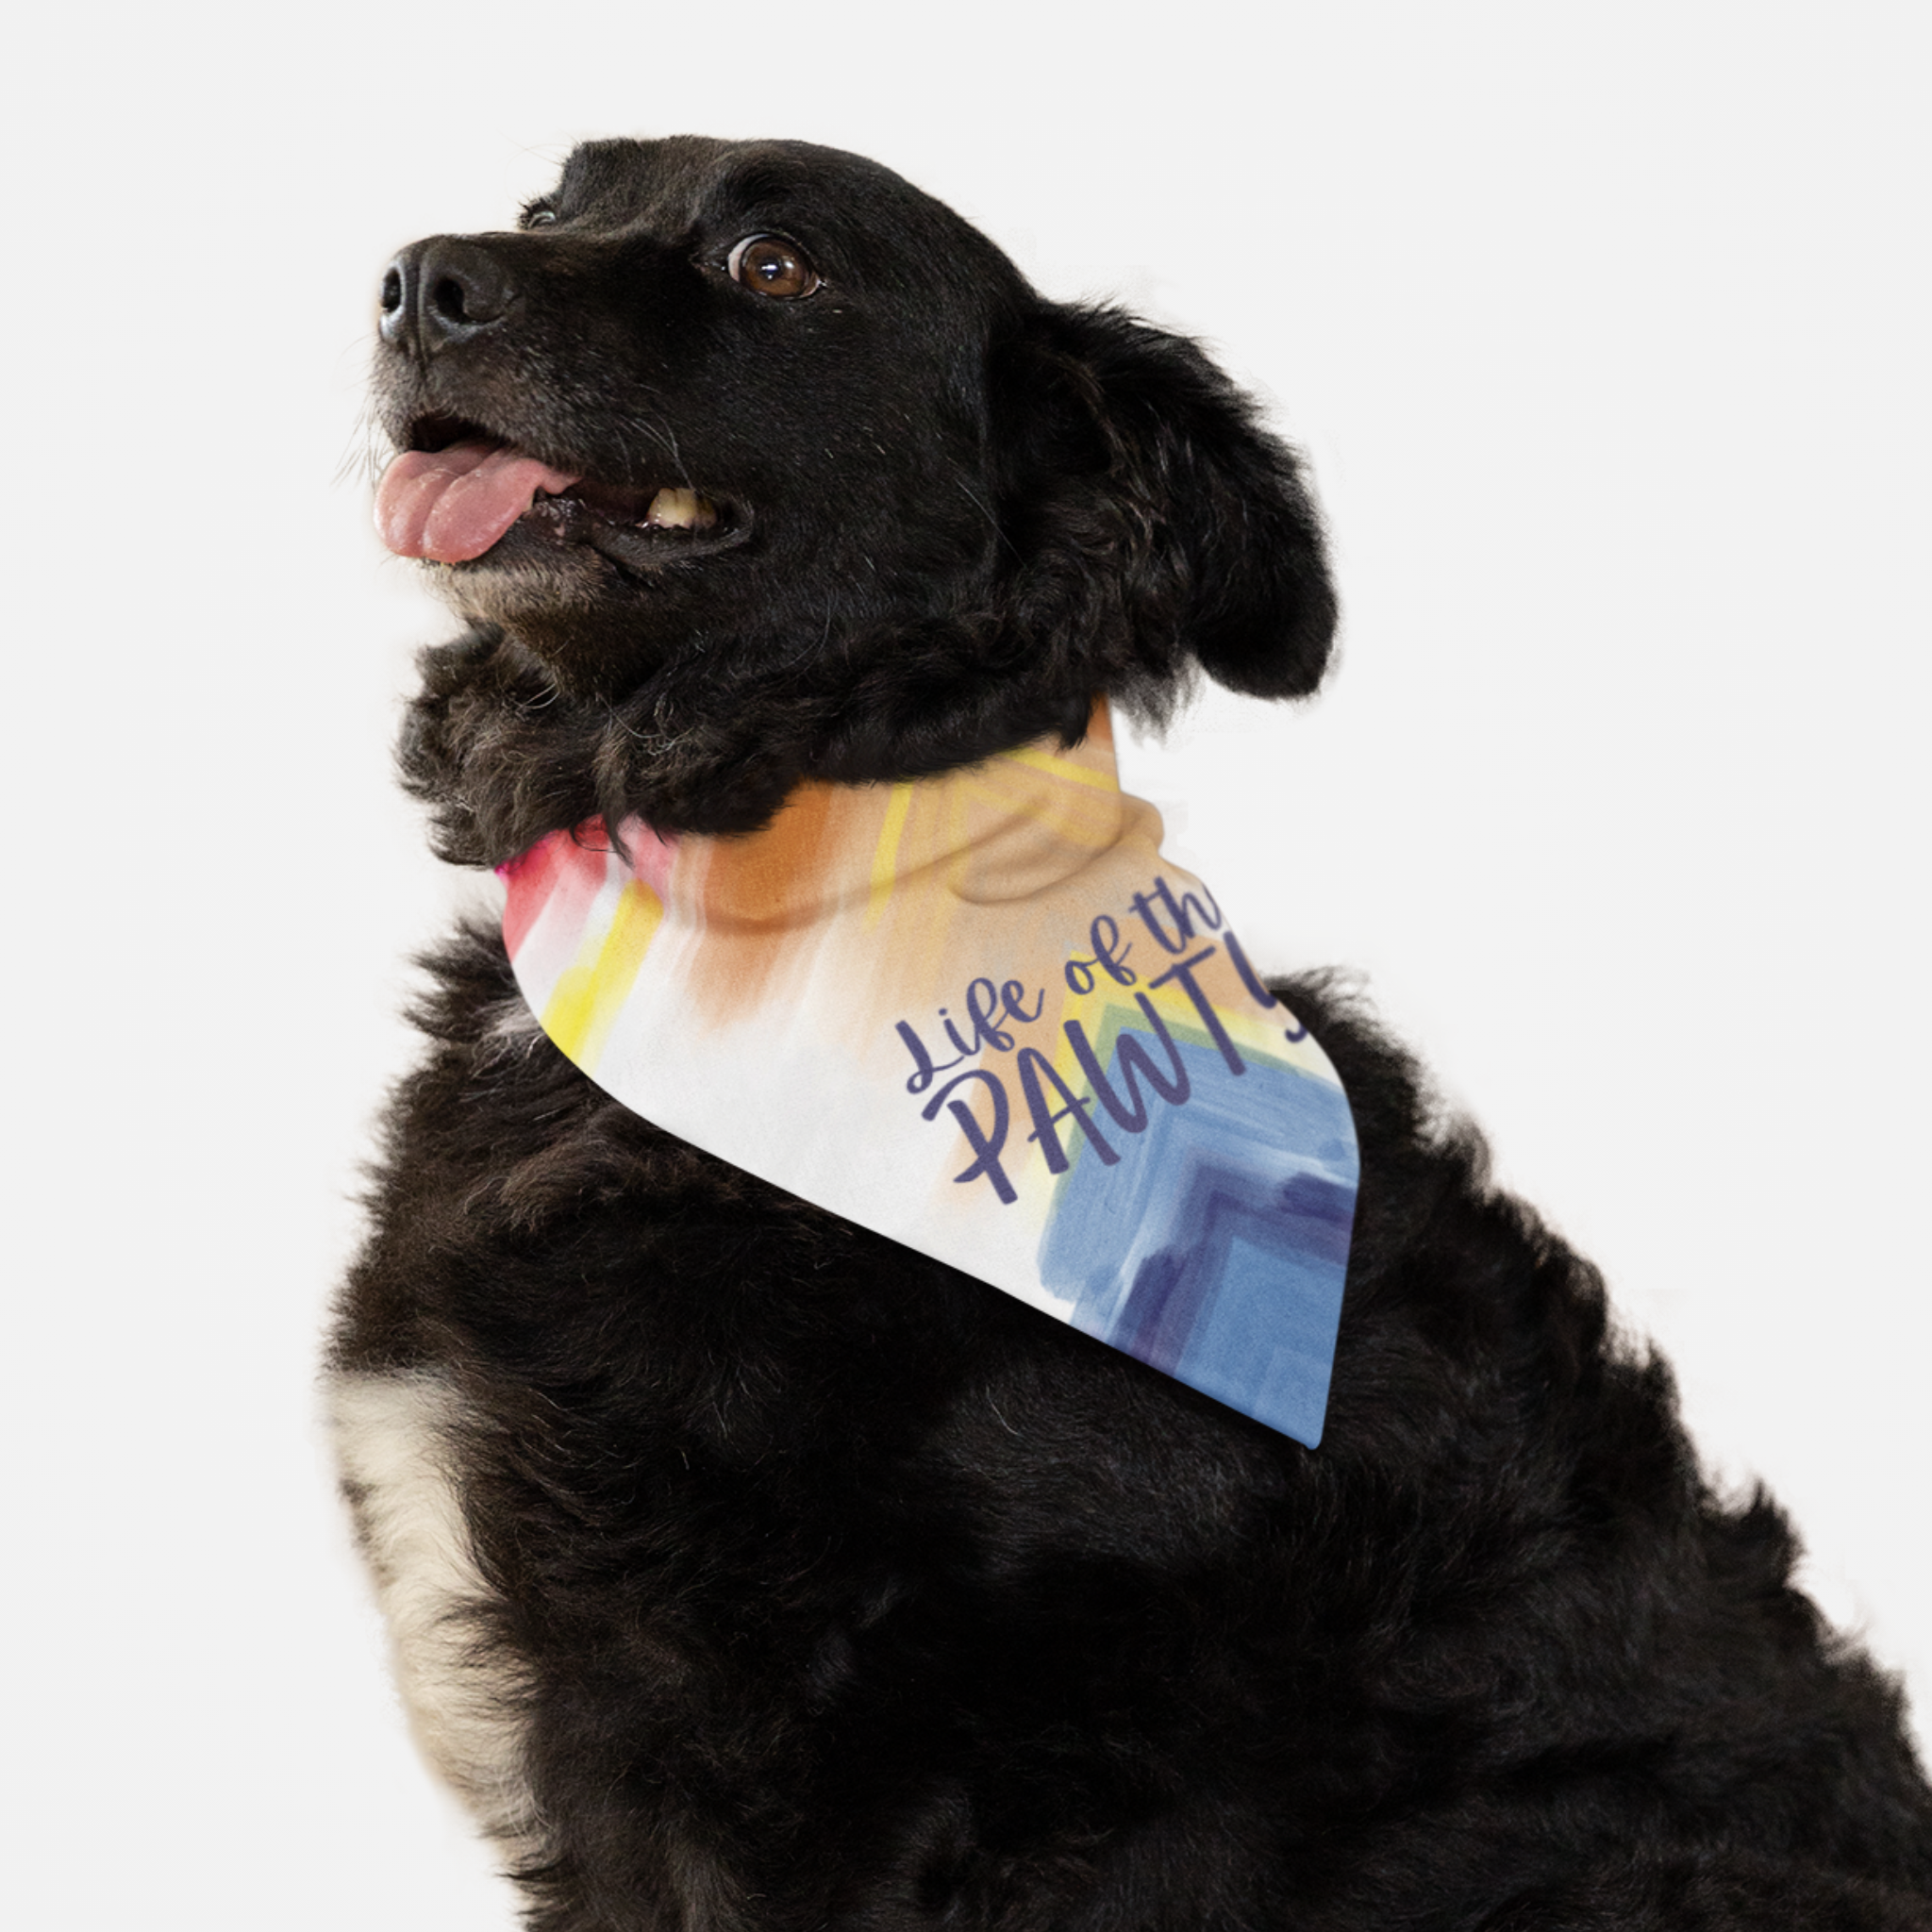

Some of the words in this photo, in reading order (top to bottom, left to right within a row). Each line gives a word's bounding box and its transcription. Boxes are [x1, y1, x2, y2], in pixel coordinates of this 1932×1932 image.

[895, 977, 1045, 1094] Life
[1064, 914, 1138, 995] of
[1128, 876, 1223, 955] th
